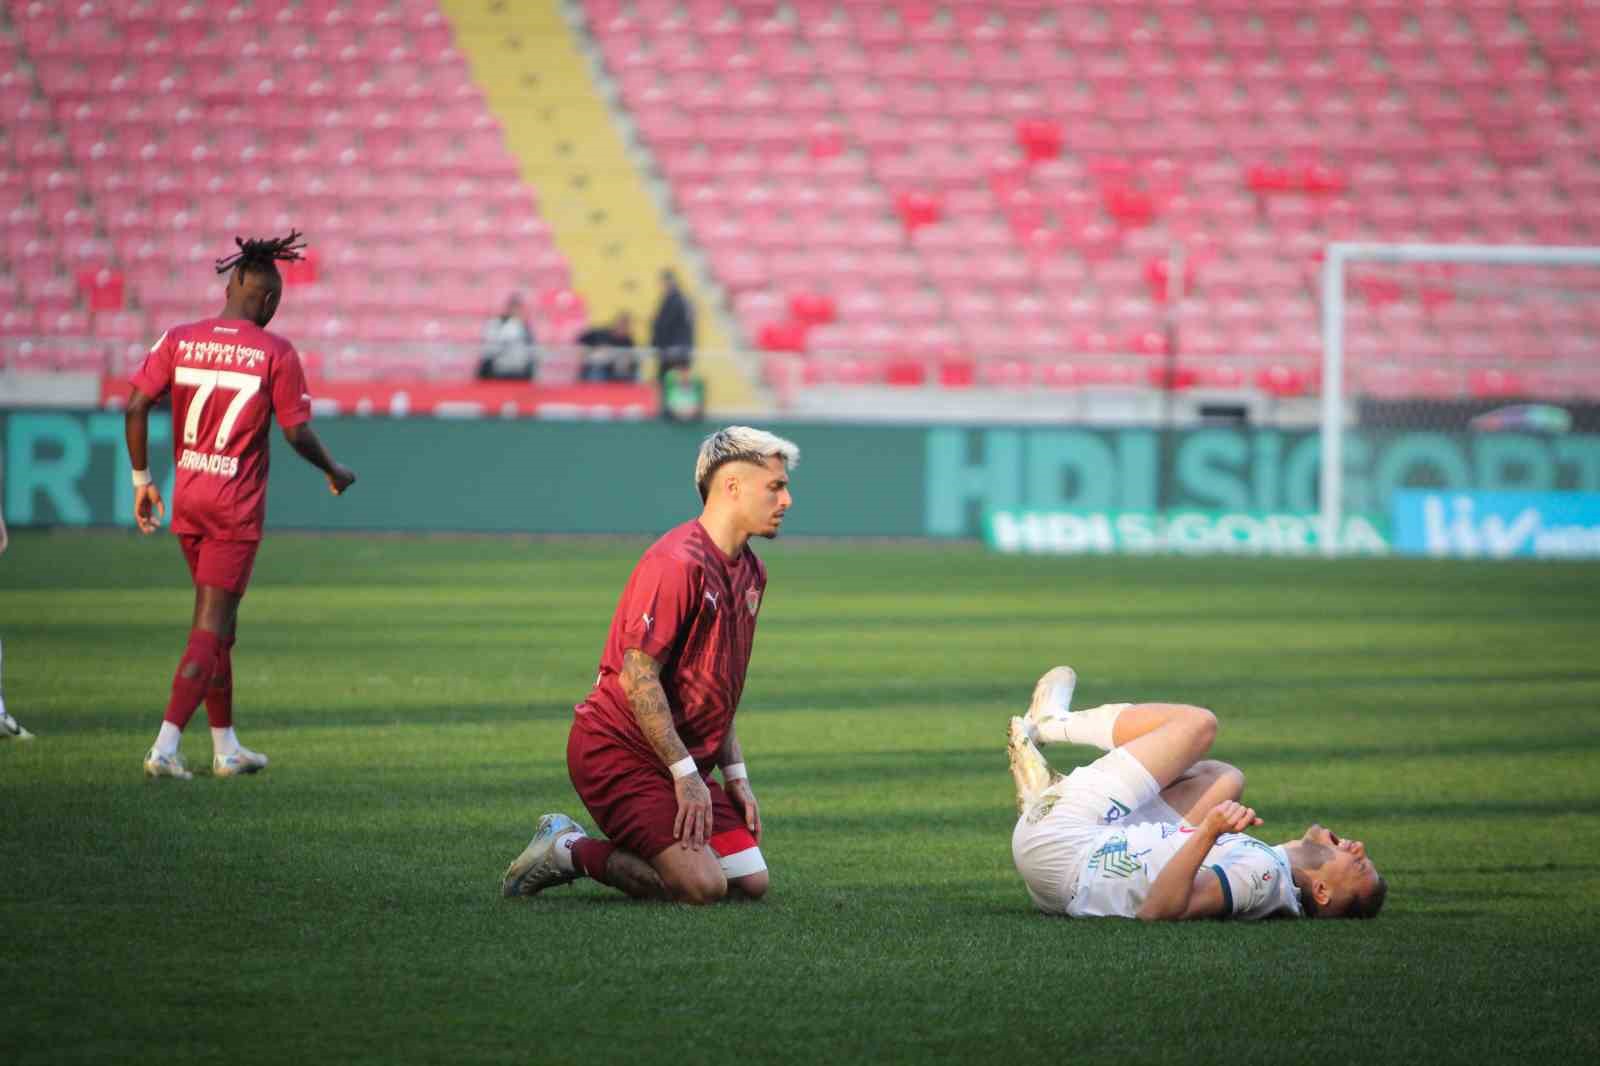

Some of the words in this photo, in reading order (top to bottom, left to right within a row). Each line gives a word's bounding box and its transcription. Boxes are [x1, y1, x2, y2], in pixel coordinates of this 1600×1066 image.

[175, 366, 262, 451] 77
[6, 413, 173, 526] RT
[925, 425, 1157, 536] HDI
[1177, 428, 1600, 513] SIGOR
[991, 511, 1114, 552] HDI
